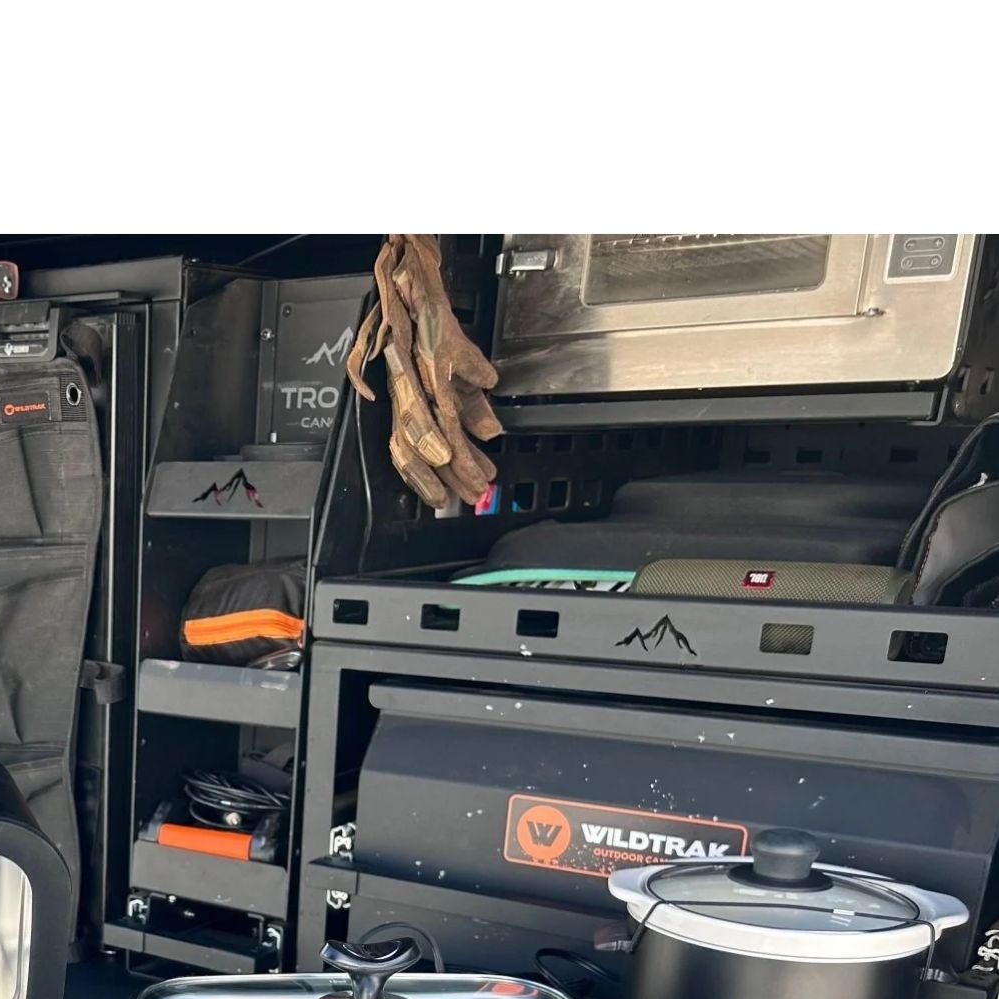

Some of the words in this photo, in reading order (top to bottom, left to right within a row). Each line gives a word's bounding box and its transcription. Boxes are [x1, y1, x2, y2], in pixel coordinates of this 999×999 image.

[281, 386, 340, 409] TRO
[300, 417, 334, 429] CAN
[749, 573, 769, 584] JBL
[580, 823, 730, 858] WILDTRAK
[592, 847, 644, 863] OUTDOOR
